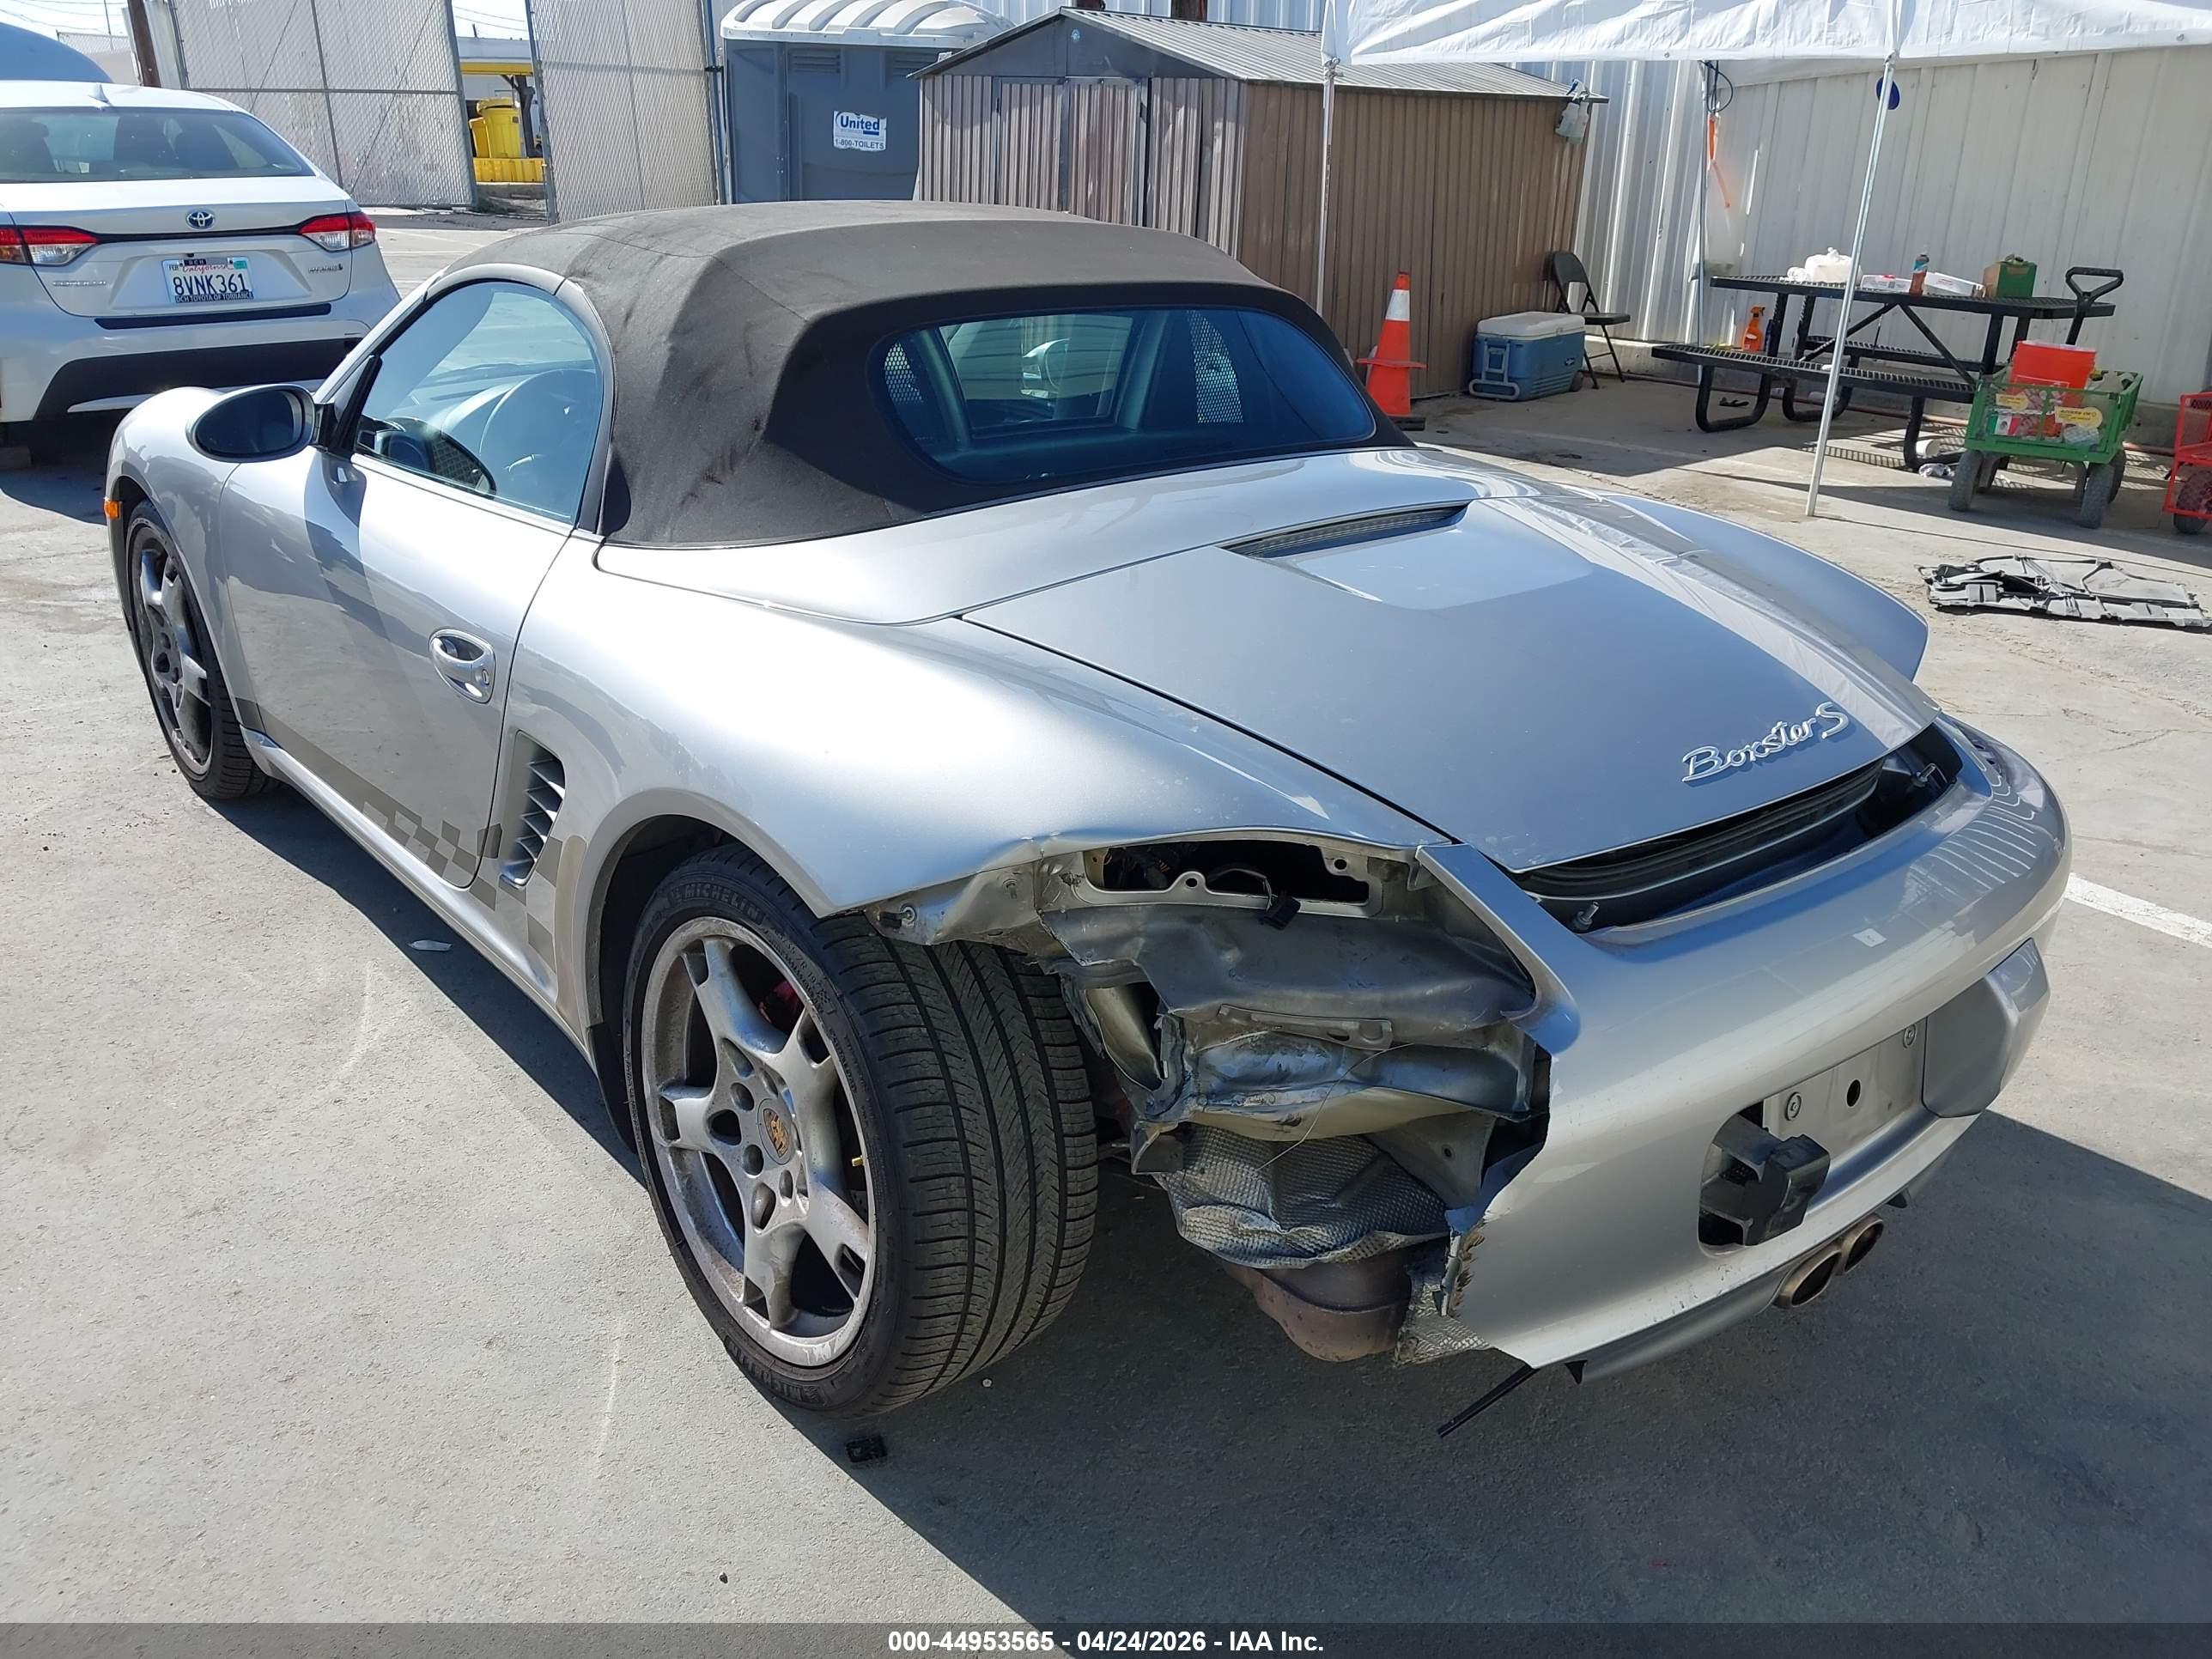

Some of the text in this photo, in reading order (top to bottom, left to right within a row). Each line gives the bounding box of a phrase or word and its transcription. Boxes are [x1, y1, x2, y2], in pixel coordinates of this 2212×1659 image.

[841, 115, 880, 131] United
[173, 273, 249, 296] 8VNK361
[1681, 701, 1849, 782] Boxster S
[685, 883, 762, 921] MICHELIN
